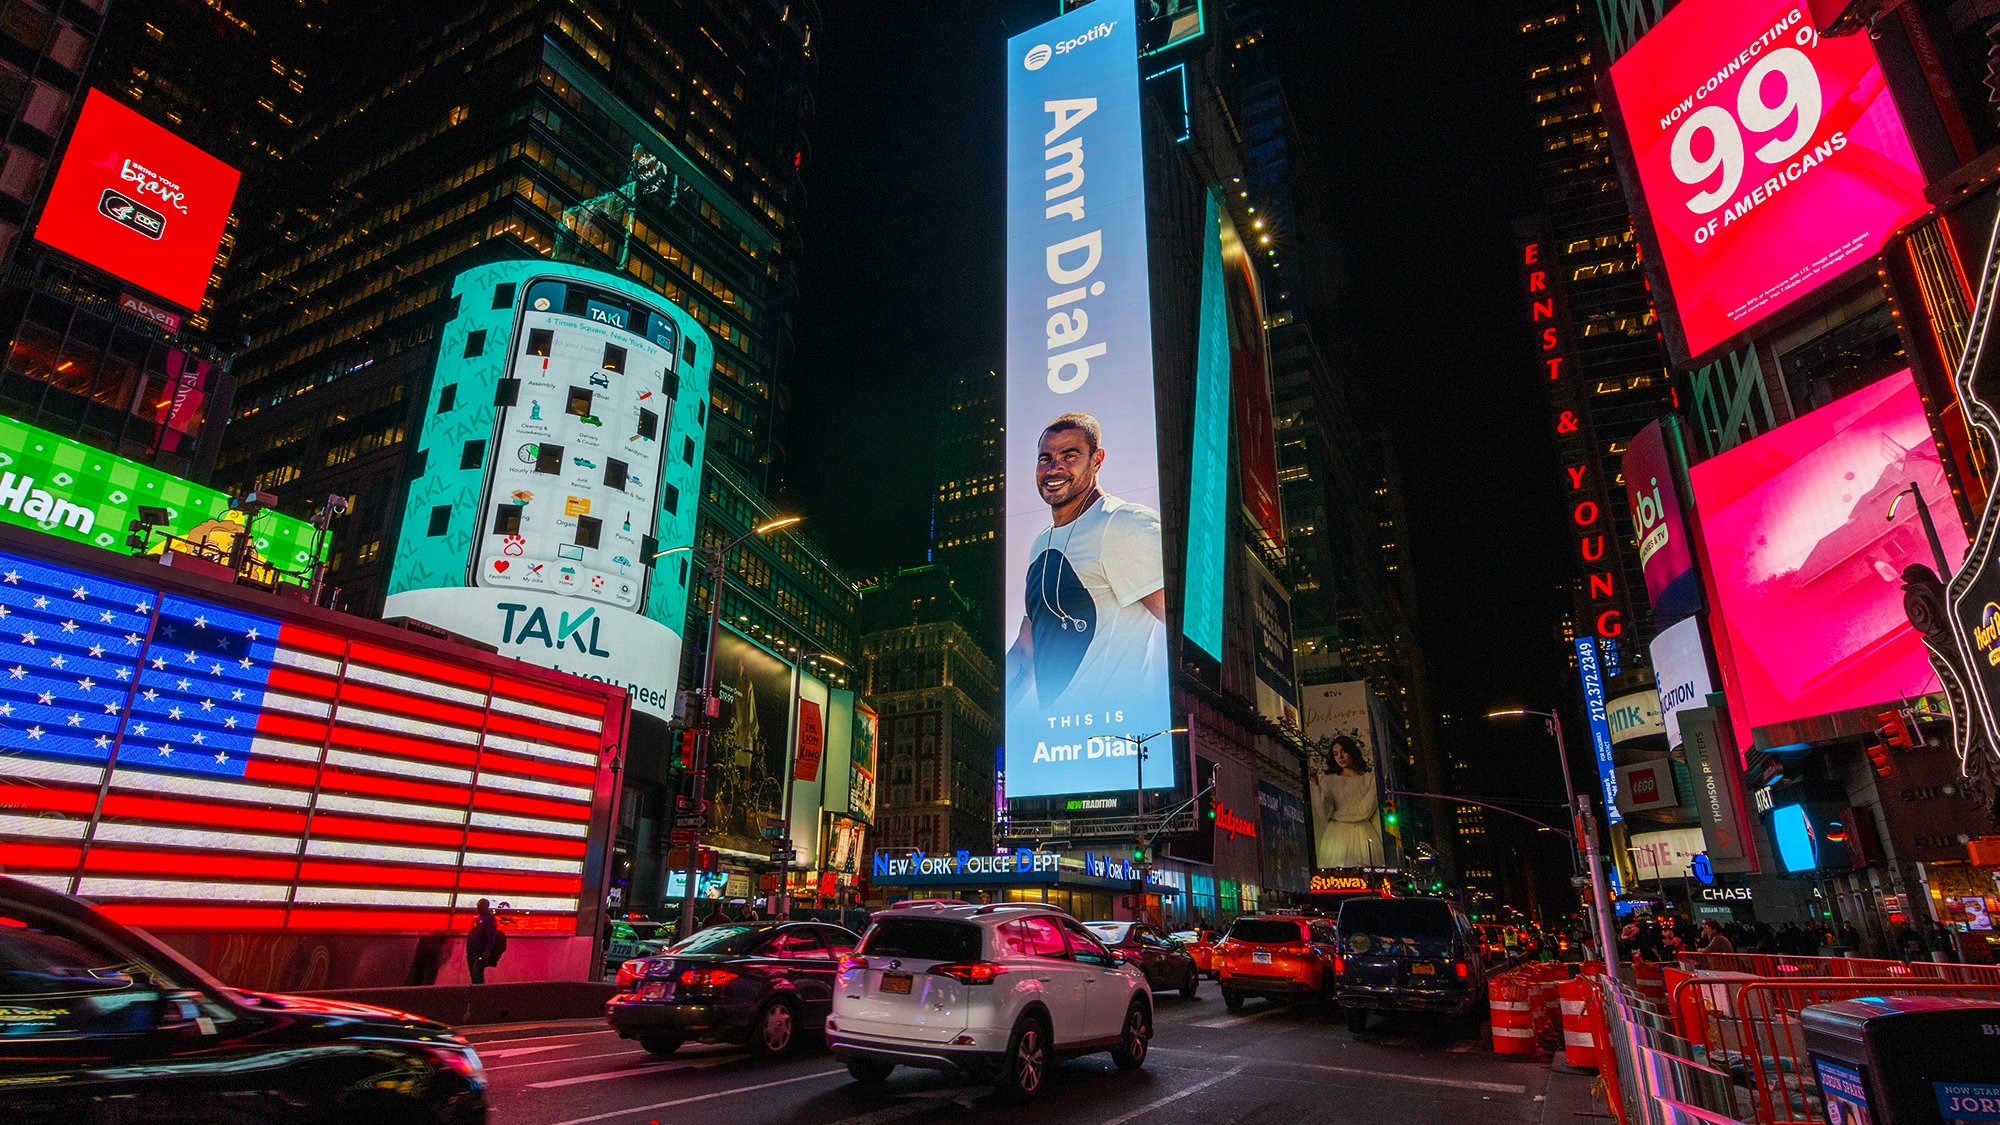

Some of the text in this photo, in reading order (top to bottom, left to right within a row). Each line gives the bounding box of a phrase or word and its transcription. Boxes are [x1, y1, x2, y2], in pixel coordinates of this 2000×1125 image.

[1055, 22, 1115, 56] Spotify
[1660, 8, 1802, 130] NOW CONNECTING
[132, 162, 180, 191] BRING YOUR
[1693, 131, 1848, 244] OF AMERICANS
[137, 214, 160, 231] CDC
[1044, 97, 1107, 395] Amr Diab
[1764, 279, 1789, 296] Americans
[1828, 248, 1841, 258] does
[1842, 242, 1851, 250] not
[1852, 231, 1869, 245] depict
[1821, 253, 1845, 270] coverage
[591, 308, 623, 328] TAKL
[1524, 243, 1563, 381] ERNST
[554, 318, 577, 329] Times
[580, 323, 608, 336] Square,
[611, 332, 627, 343] New
[630, 337, 645, 350] York,
[647, 346, 658, 355] NY
[565, 341, 579, 350] you
[528, 380, 556, 390] Assembly
[521, 423, 543, 431] Cleaning
[1557, 410, 1579, 434] &
[579, 432, 599, 441] Delivery
[509, 467, 528, 475] Hourly
[1, 471, 95, 534] Ham
[615, 533, 635, 544] Painting
[1657, 530, 1665, 542] TV
[1567, 466, 1621, 638] YOUNG
[497, 602, 610, 658] TAKL
[1579, 642, 1606, 721] 212.372.2349
[628, 683, 667, 710] need
[805, 722, 817, 732] THE
[1048, 710, 1124, 729] THIS IS
[801, 730, 819, 745] LION
[1032, 733, 1141, 763] Amr Diab
[800, 744, 819, 760] KING
[1633, 779, 1654, 793] LEGO
[1705, 775, 1722, 824] THOMSON
[1755, 785, 1774, 813] AT&T
[1216, 802, 1256, 840] Walgreens
[873, 847, 1061, 877] NEW YORK POLICE DEPT
[612, 944, 632, 955] NYPD
[1945, 1086, 1970, 1095] NOW
